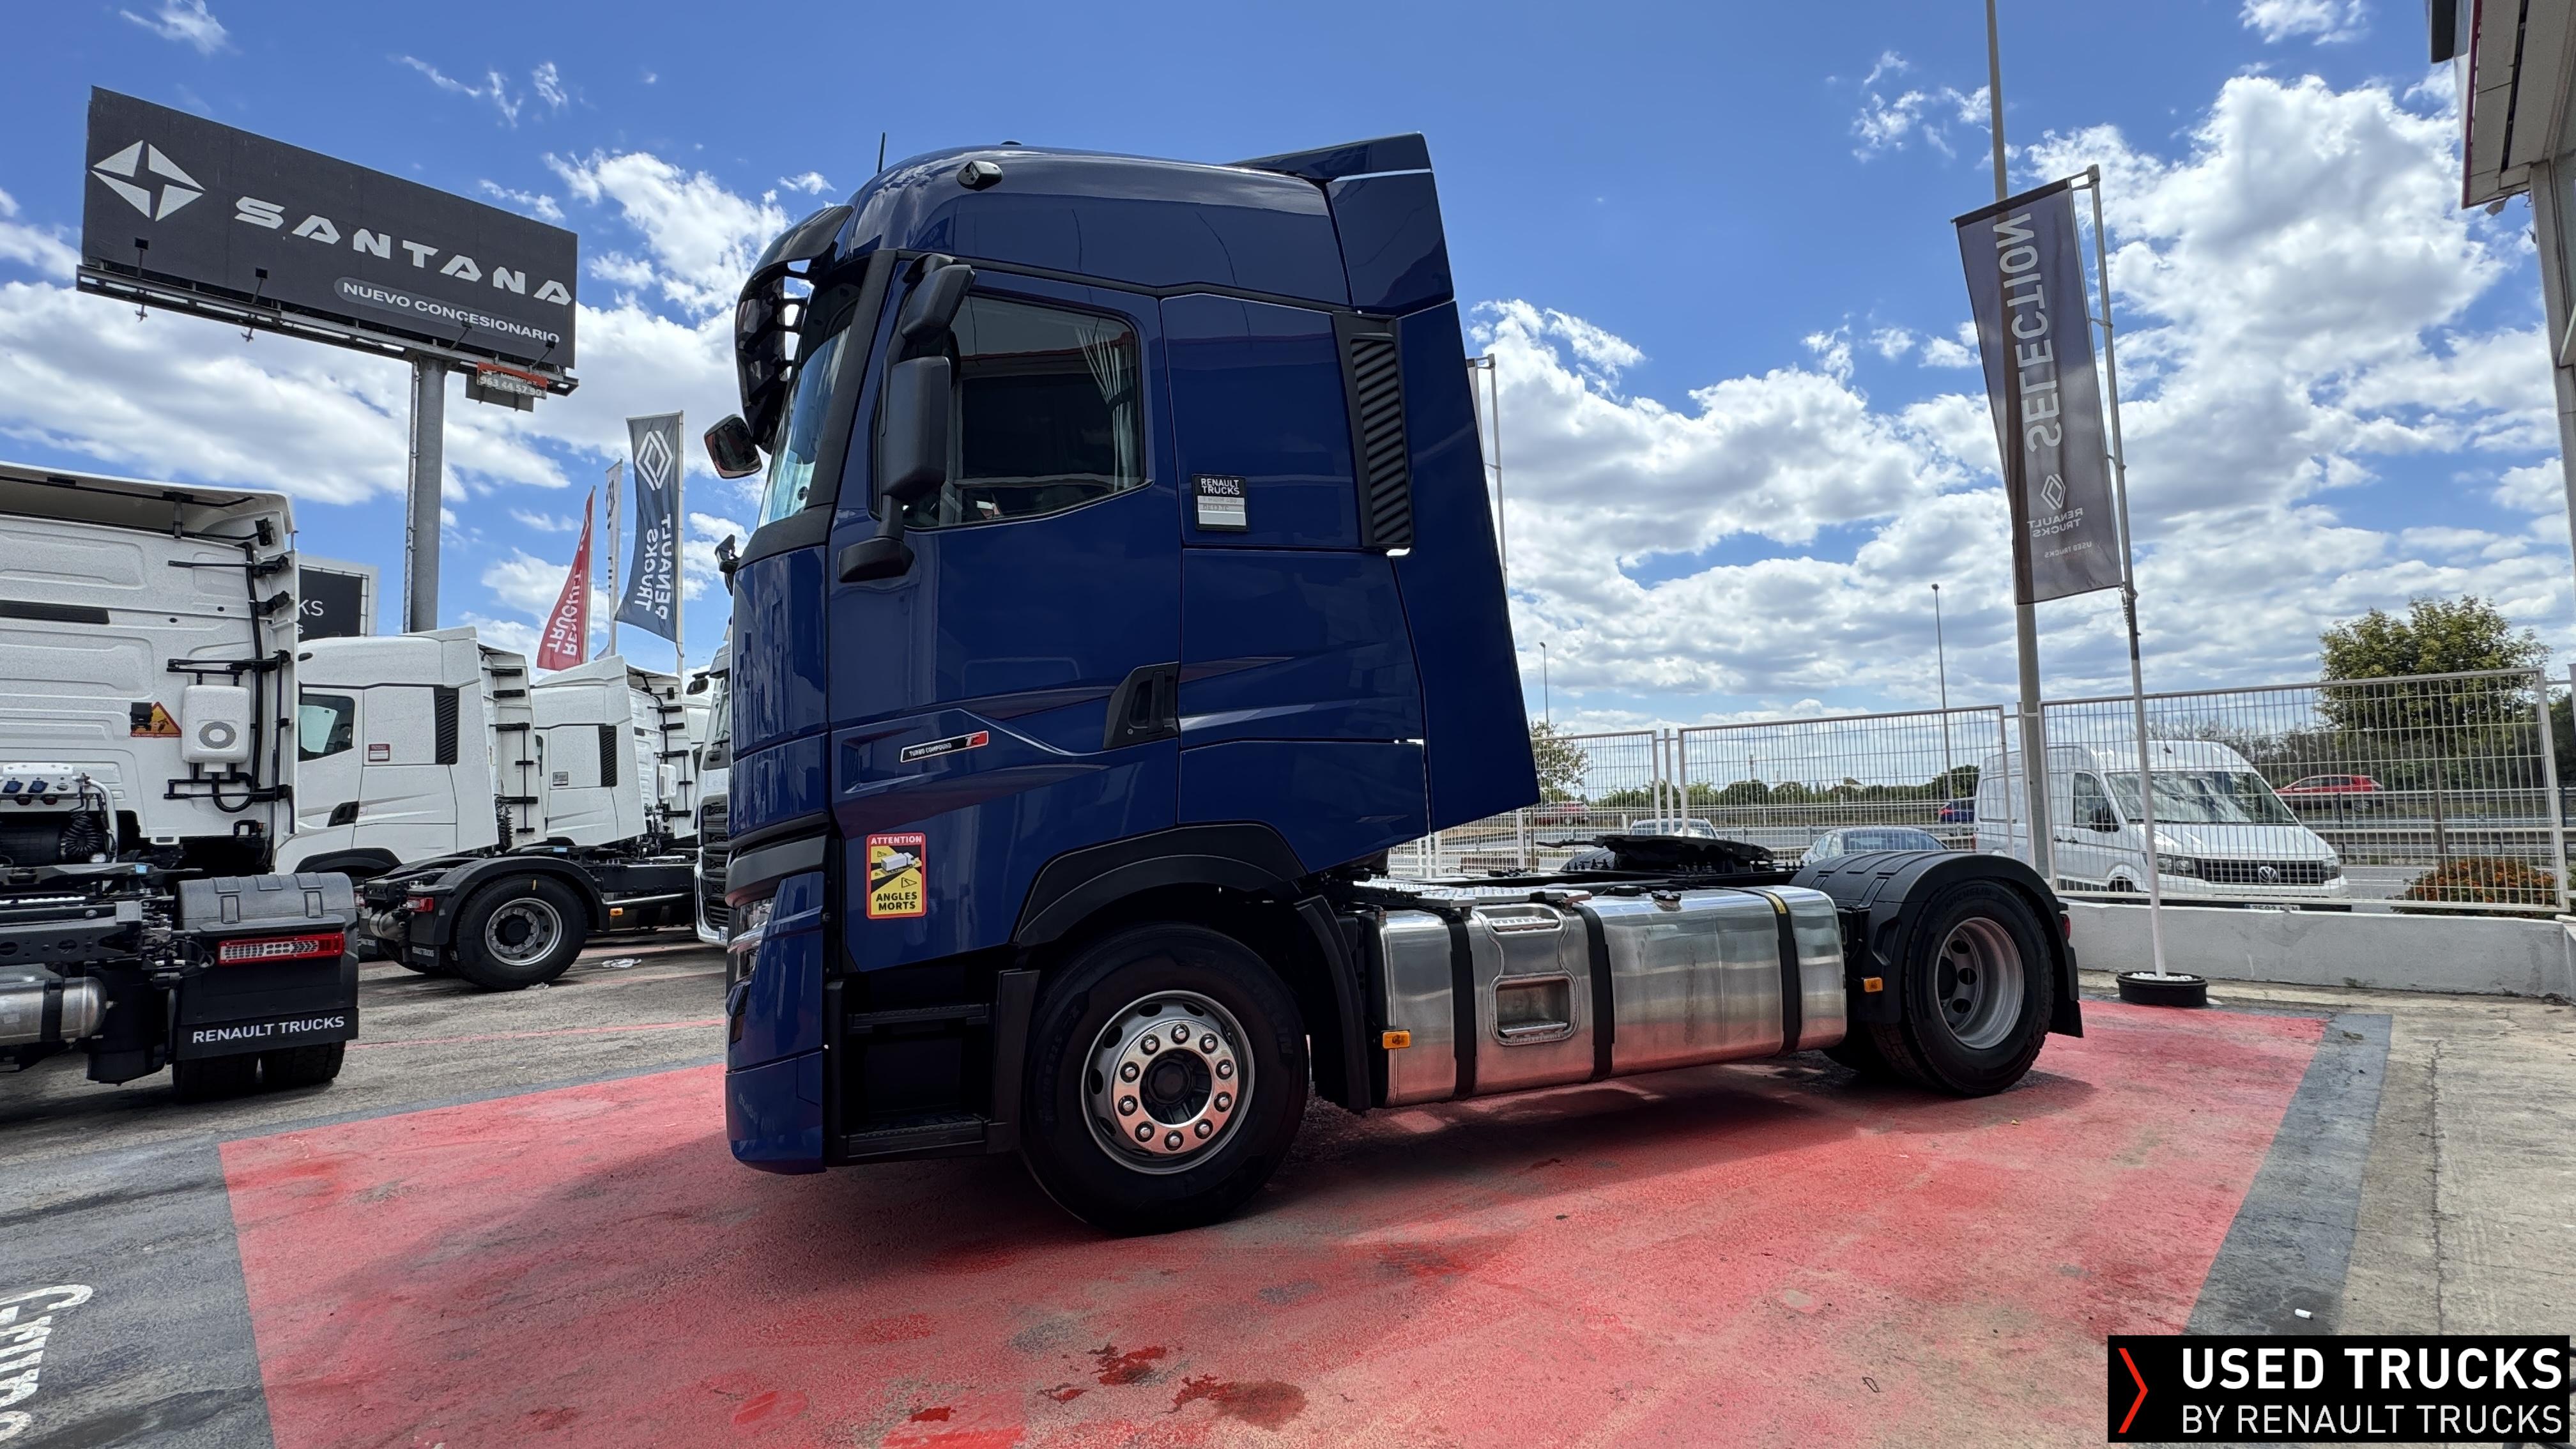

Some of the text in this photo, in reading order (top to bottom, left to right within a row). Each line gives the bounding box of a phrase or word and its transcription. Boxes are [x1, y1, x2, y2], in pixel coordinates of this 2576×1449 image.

[234, 196, 572, 306] SANTANA
[343, 282, 560, 344] NUEVO CONCESIONARIO
[1200, 478, 1239, 488] RENAULT
[1201, 486, 1240, 495] TRUCKS
[871, 836, 922, 844] ATTENTION
[876, 891, 917, 901] ANGLES
[878, 901, 916, 911] MORTS
[192, 1016, 345, 1043] RENAULT TRUCKS
